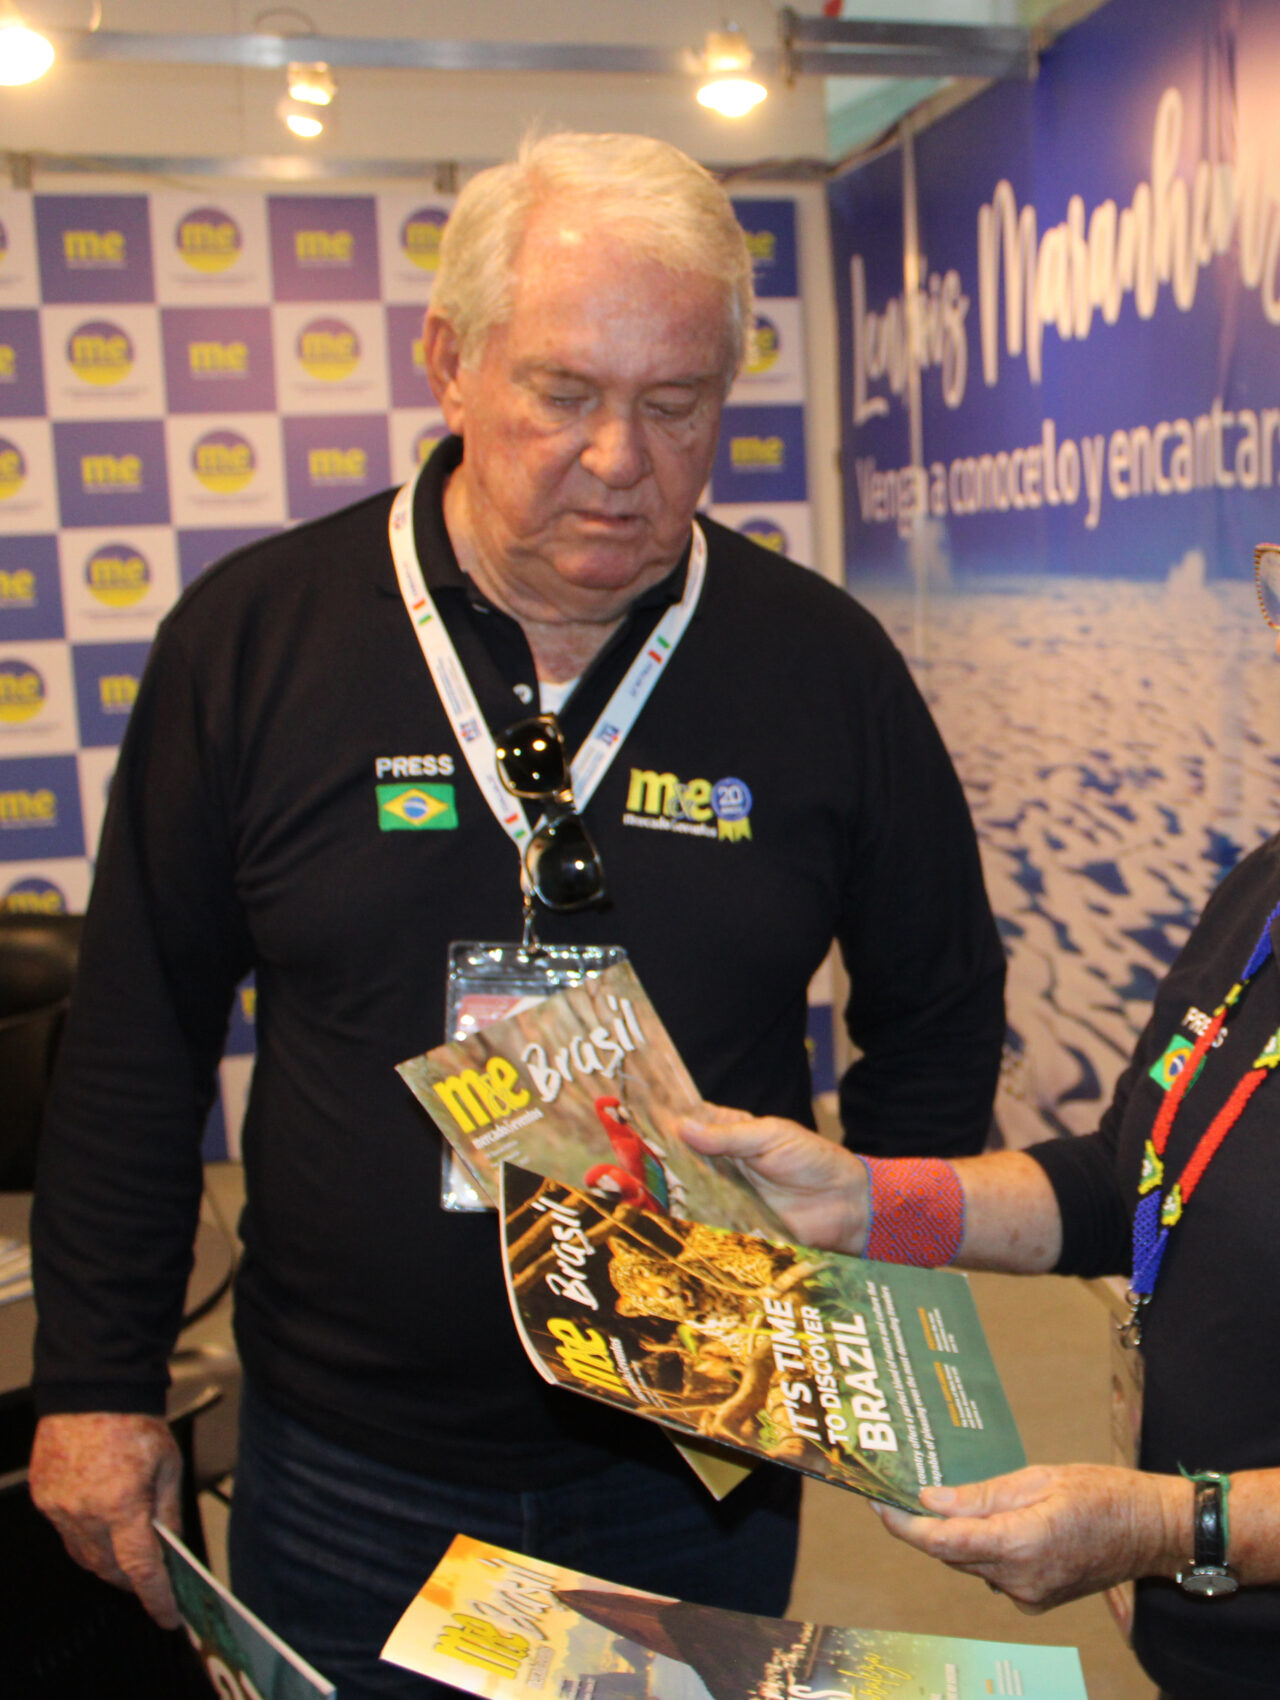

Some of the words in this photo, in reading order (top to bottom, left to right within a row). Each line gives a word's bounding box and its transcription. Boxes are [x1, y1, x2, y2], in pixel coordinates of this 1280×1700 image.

[1081, 434, 1105, 529] y
[376, 754, 455, 778] PRESS
[718, 785, 745, 806] 20
[1182, 1006, 1228, 1048] PRES
[521, 995, 646, 1103] Brasil
[531, 1196, 598, 1311] Brasil
[764, 1297, 806, 1372] TIME
[801, 1305, 844, 1409] DISCOVER
[830, 1314, 899, 1452] BRAZIL
[783, 1381, 822, 1441] IT'S
[896, 1390, 914, 1417] perfect
[824, 1413, 850, 1444] TO
[907, 1424, 921, 1449] offers
[922, 1440, 936, 1450] of
[914, 1450, 927, 1485] country
[928, 1451, 942, 1487] capable
